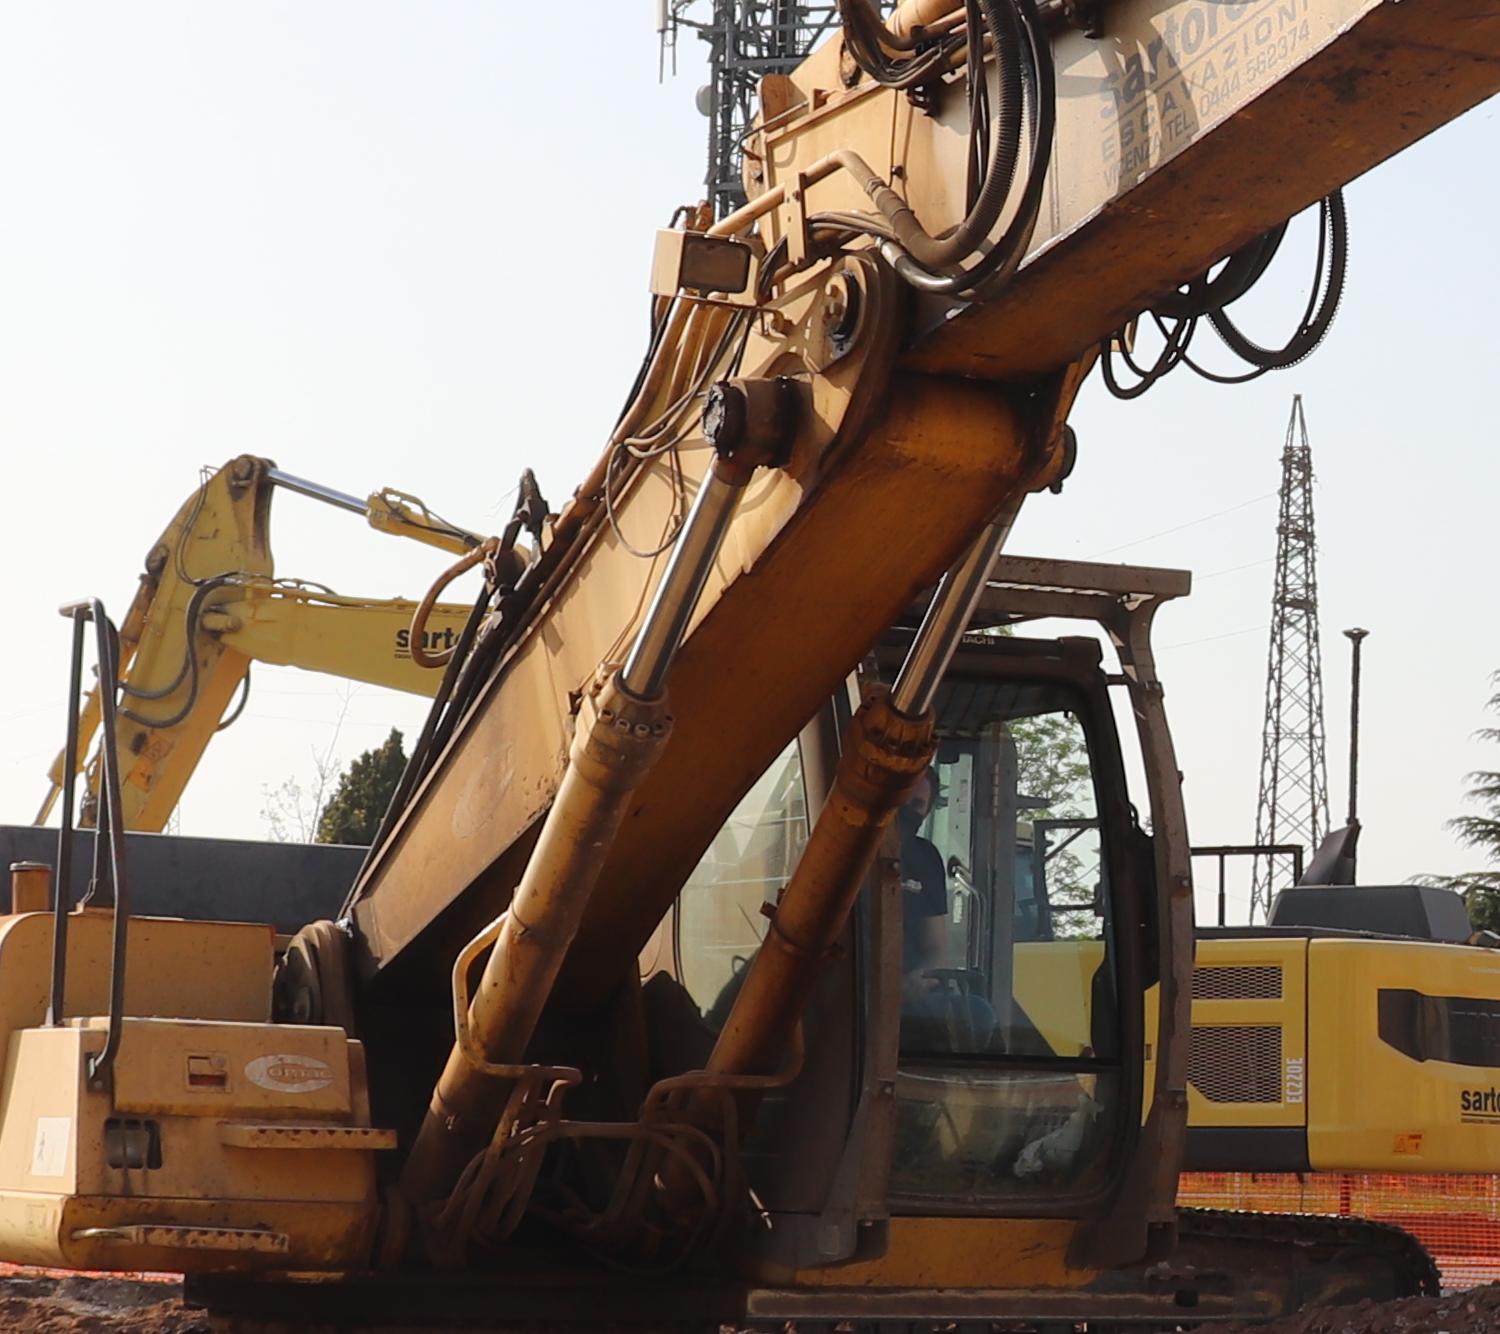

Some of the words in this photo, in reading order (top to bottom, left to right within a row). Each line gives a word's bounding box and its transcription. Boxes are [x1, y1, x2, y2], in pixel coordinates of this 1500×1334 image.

[1103, 132, 1162, 188] VICENZA
[1200, 73, 1240, 117] 0444
[1246, 19, 1310, 84] 562374
[1286, 1058, 1303, 1103] EC220E
